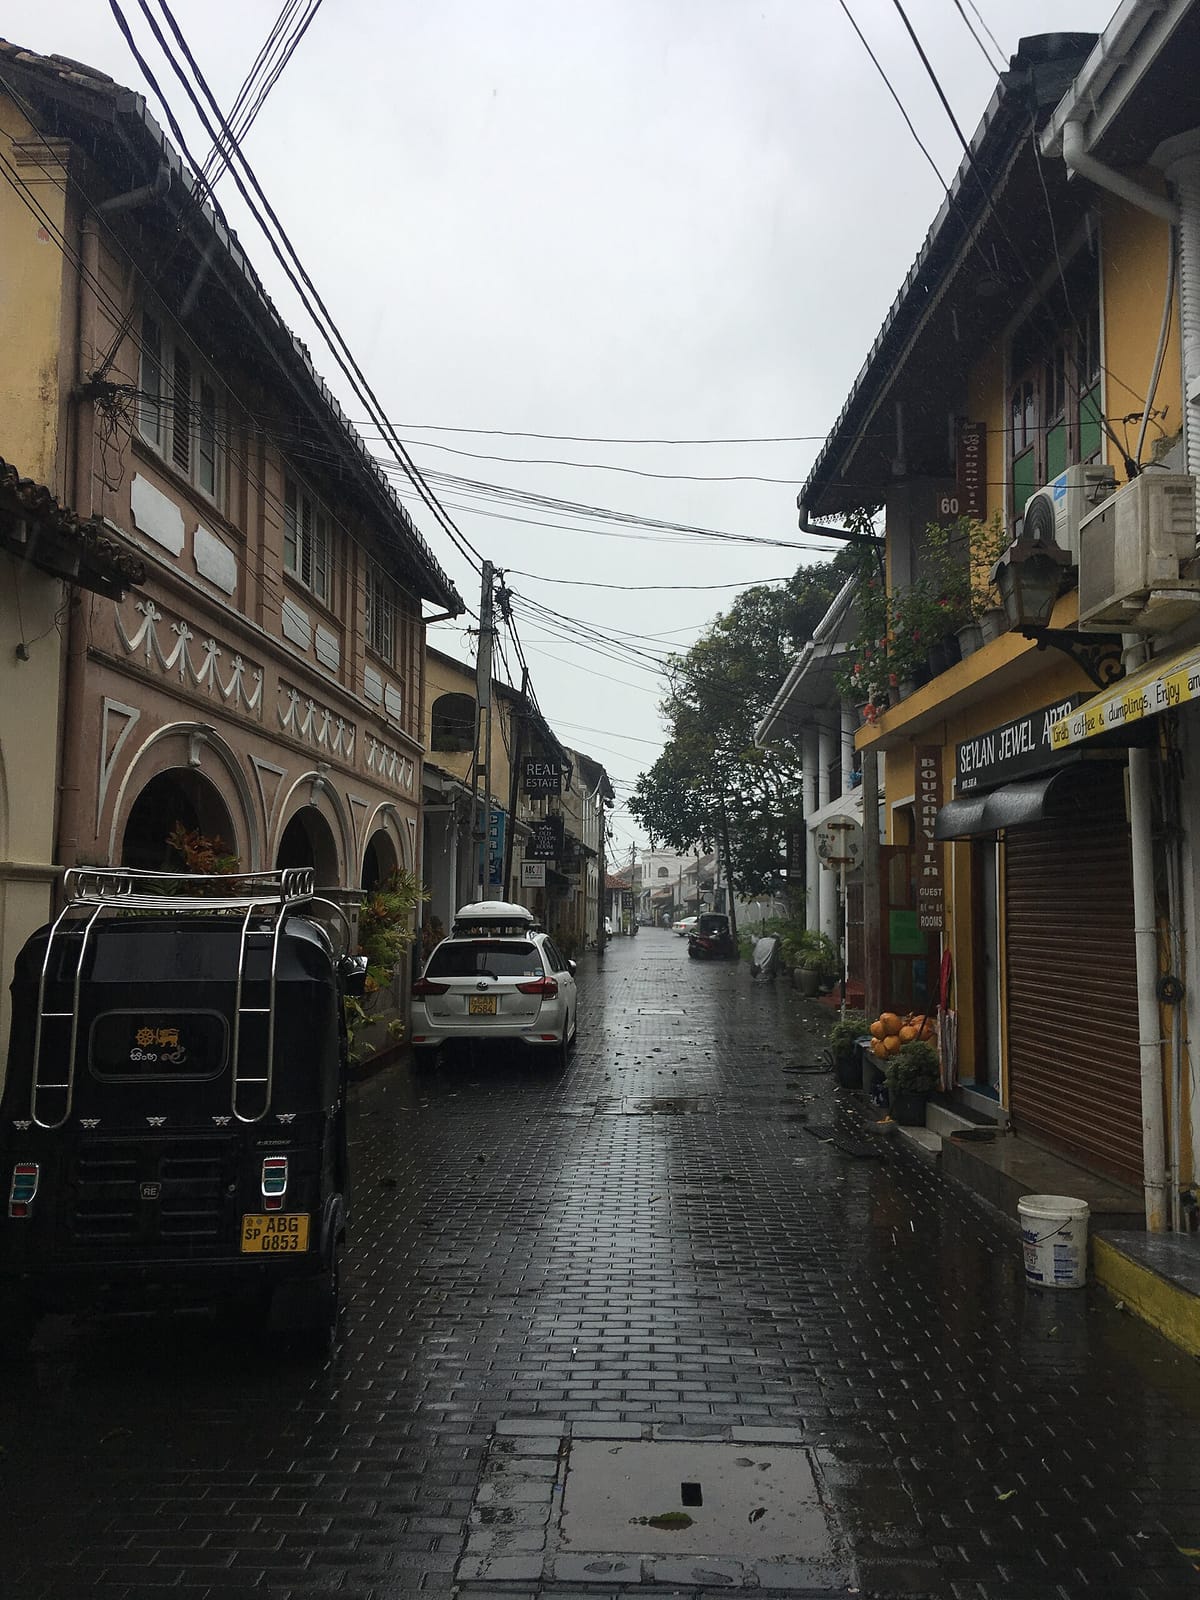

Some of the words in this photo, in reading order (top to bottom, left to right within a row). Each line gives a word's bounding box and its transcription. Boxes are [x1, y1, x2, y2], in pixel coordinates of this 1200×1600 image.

[941, 498, 959, 514] 60
[1053, 721, 1070, 743] Grab
[1073, 713, 1096, 736] coffee
[1098, 713, 1105, 726] &
[1108, 694, 1152, 720] dumplings,
[1156, 682, 1180, 706] Enjoy
[1187, 674, 1200, 692] am
[960, 735, 995, 774] SEYLAN
[998, 719, 1036, 761] JEWEL
[526, 763, 559, 776] REAL
[526, 778, 559, 788] ESTATE
[920, 758, 938, 875] BOUGANVILA
[525, 865, 535, 874] ABC
[919, 888, 942, 897] GUEST
[920, 915, 943, 927] ROOMS
[266, 1217, 298, 1233] ABG
[245, 1228, 261, 1240] SP
[262, 1235, 299, 1250] 0853
